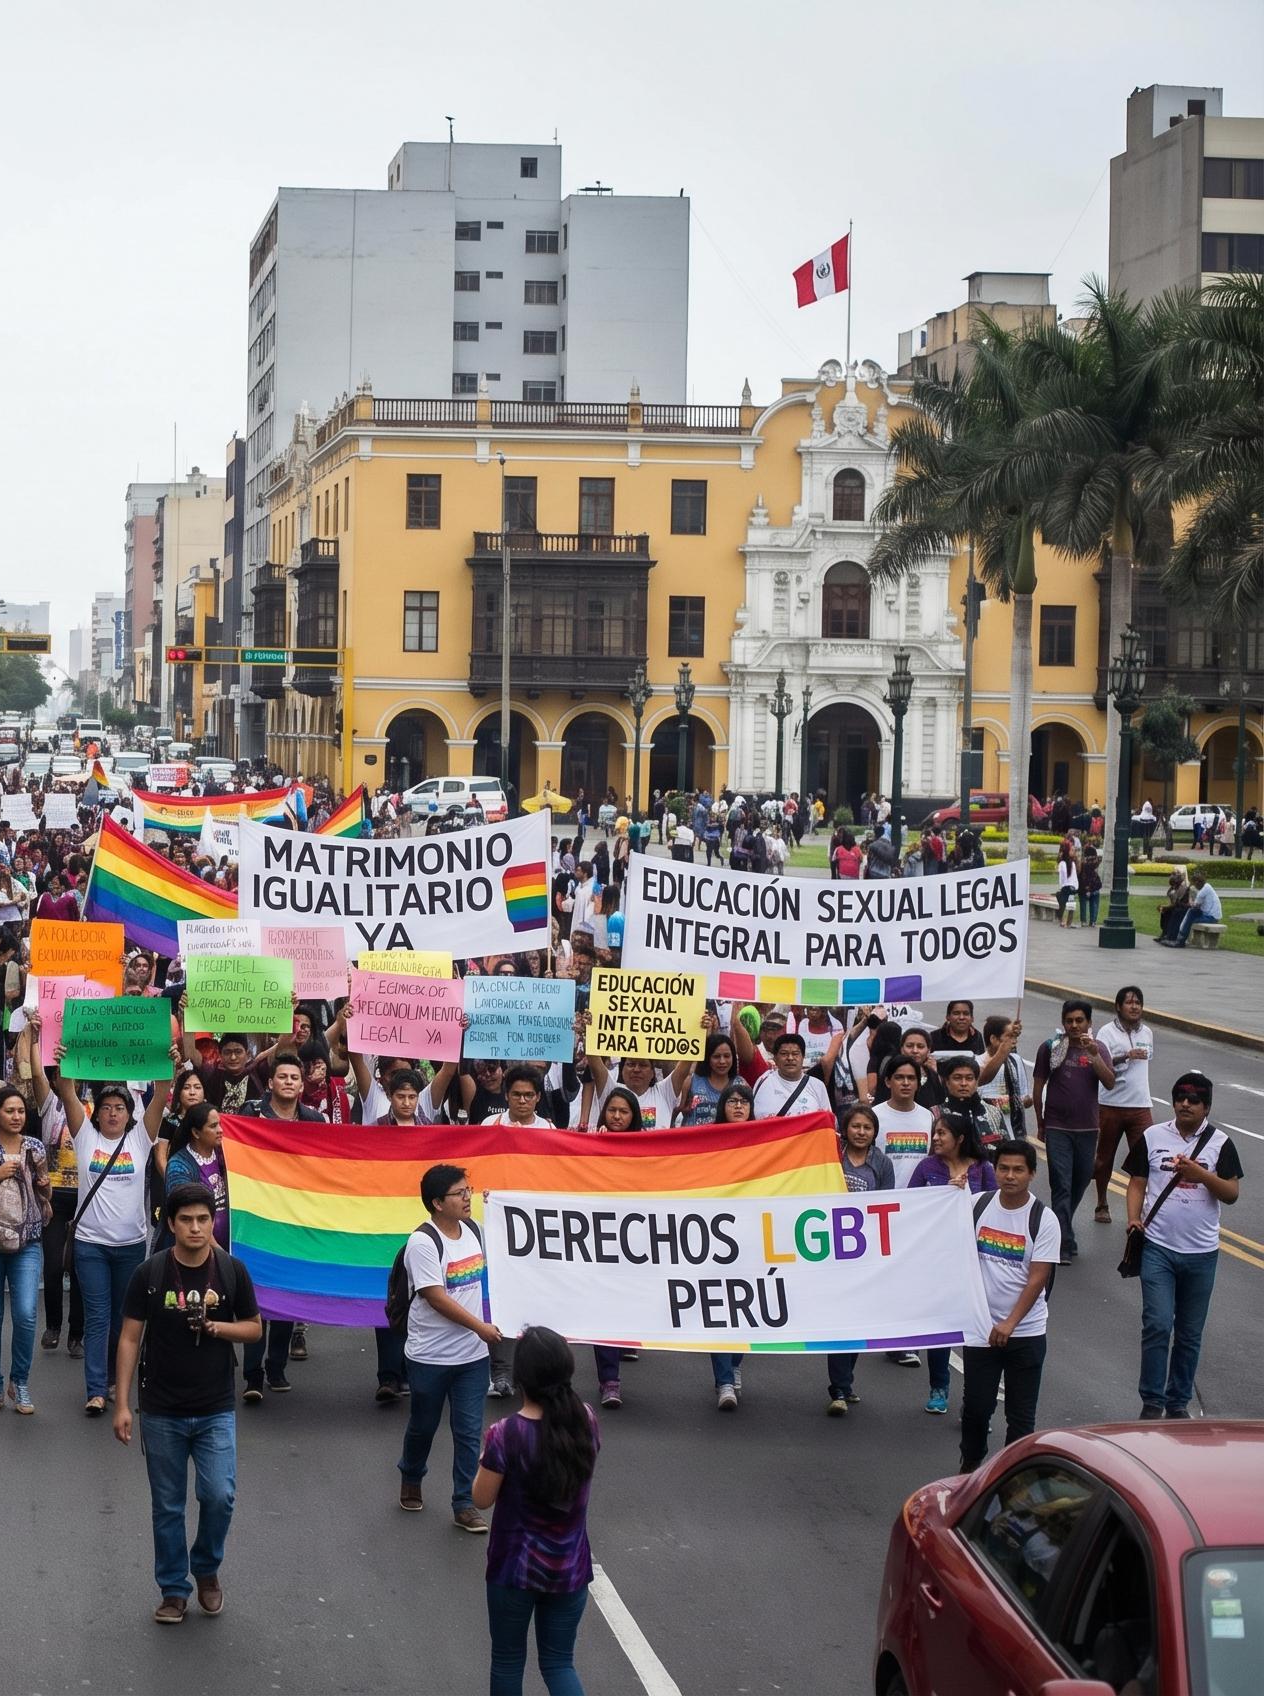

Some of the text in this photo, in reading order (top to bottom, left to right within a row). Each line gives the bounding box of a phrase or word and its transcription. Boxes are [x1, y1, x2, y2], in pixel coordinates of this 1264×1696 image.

[264, 832, 512, 878] MATRIMONIO
[253, 873, 493, 917] IGUALITARIO
[642, 866, 1024, 923] EDUCACIÓN SEXUAL LEGAL
[355, 922, 415, 951] YA
[645, 913, 1018, 967] INTEGRAL PARA TOD@S
[597, 972, 695, 996] EDUCACIÓN
[608, 994, 678, 1014] SEXUAL
[360, 1023, 442, 1045] LEGAL YA
[598, 1013, 687, 1034] INTEGRAL
[596, 1032, 701, 1056] PARA TOD@S
[503, 1202, 901, 1266] DERECHOS LGBT
[667, 1266, 790, 1329] PERÚ
